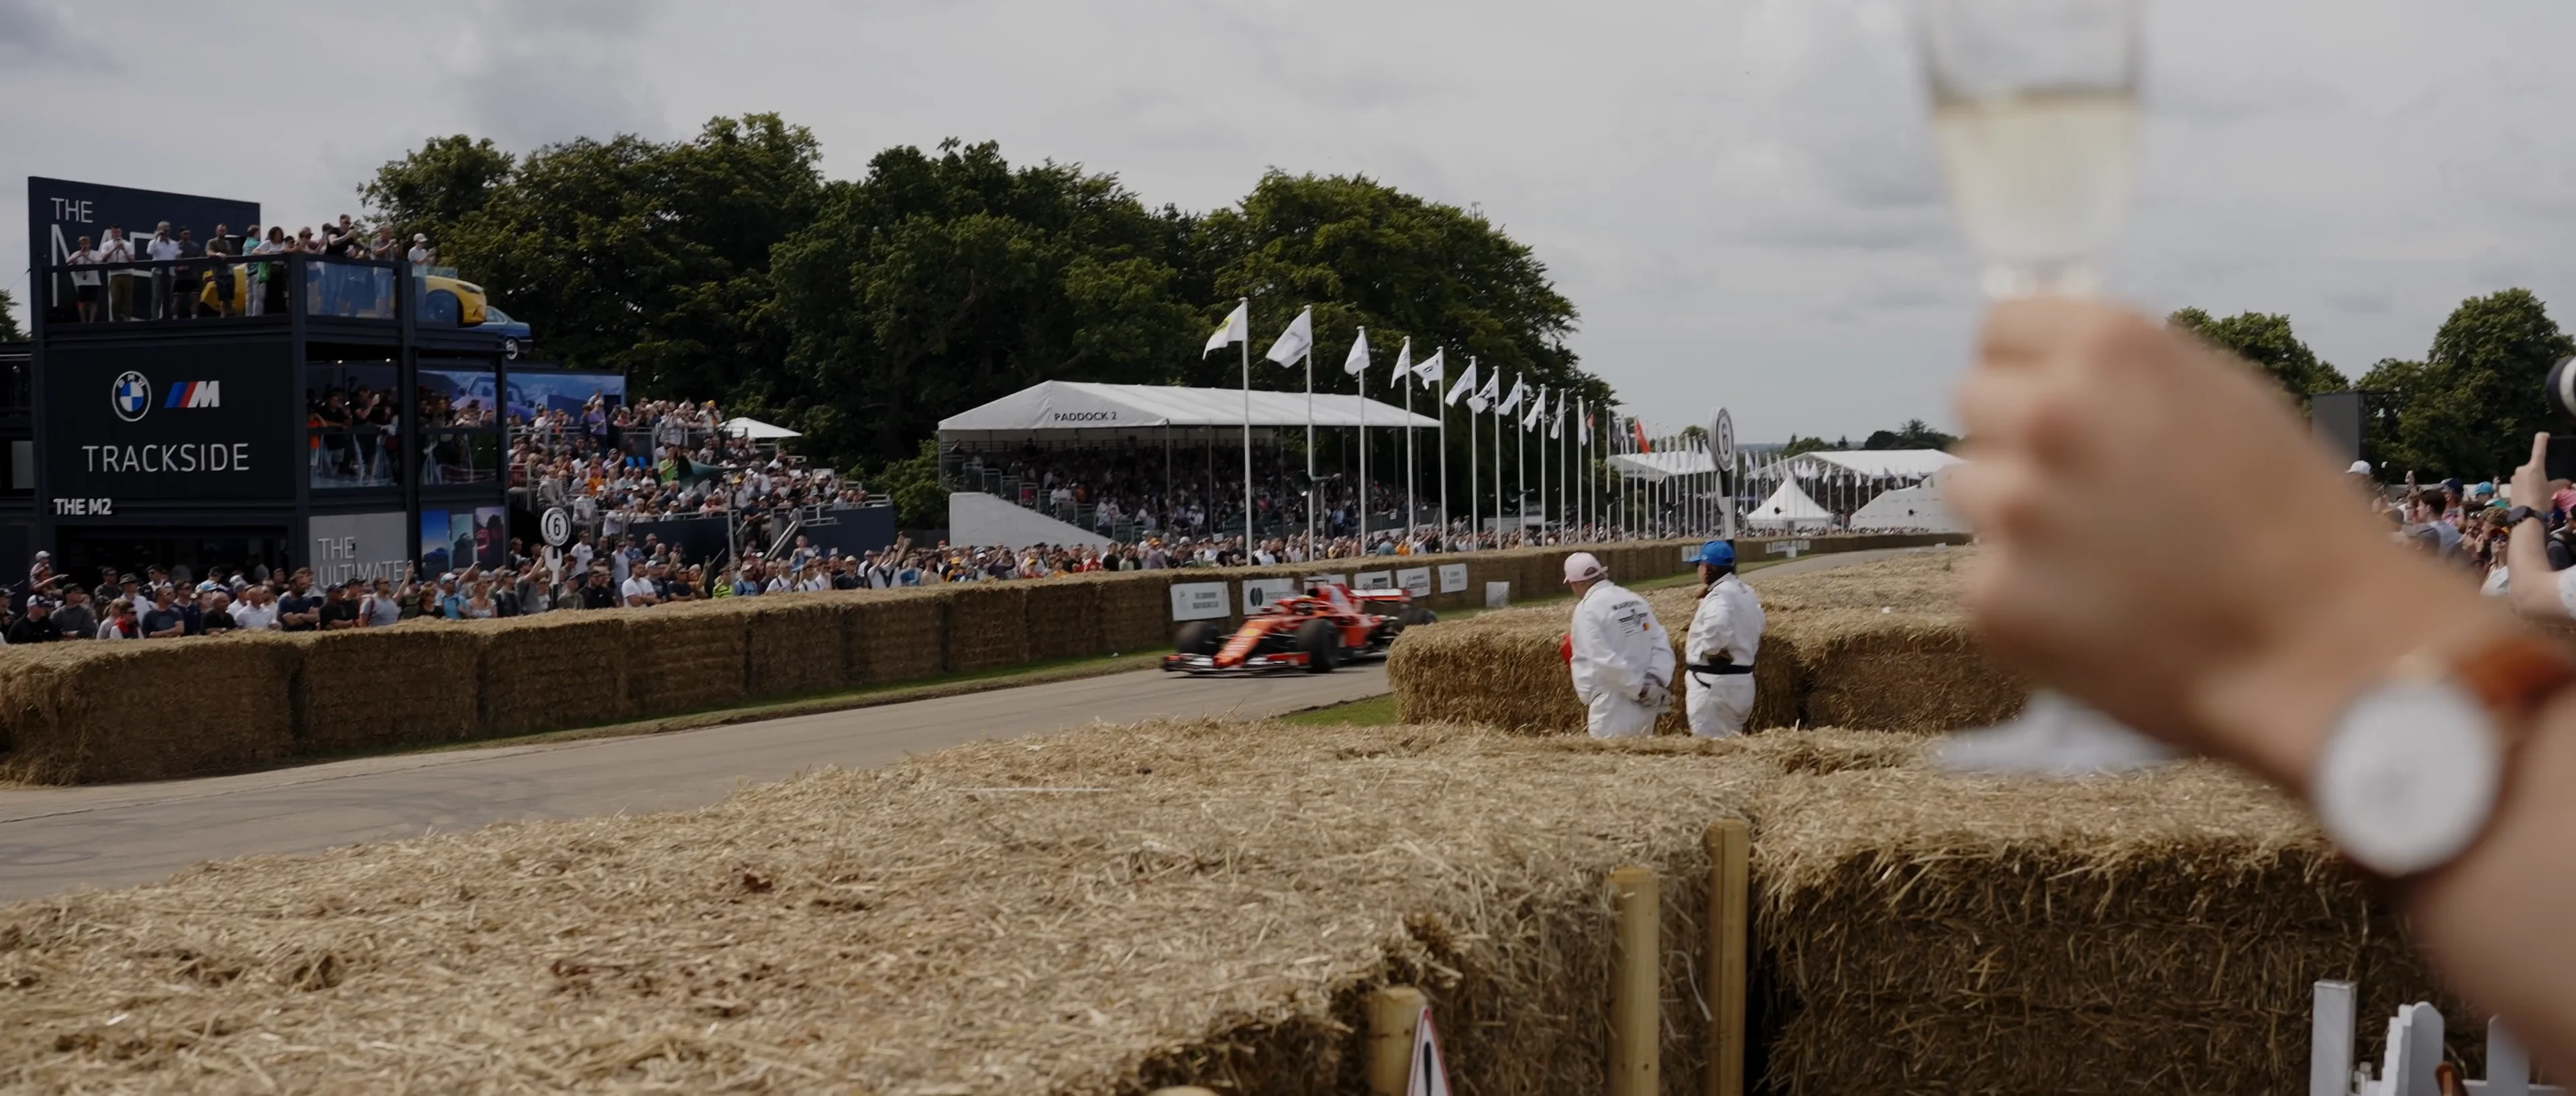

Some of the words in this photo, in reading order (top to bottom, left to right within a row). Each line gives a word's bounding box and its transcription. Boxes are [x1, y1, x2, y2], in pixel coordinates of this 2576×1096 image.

[50, 197, 93, 223] THE
[1055, 411, 1108, 421] PADDOCK
[1110, 410, 1118, 421] 2
[81, 443, 250, 472] TRACKSIDE
[53, 498, 86, 515] THE
[89, 498, 112, 515] M2
[553, 517, 561, 536] 6
[317, 537, 356, 560] THE
[319, 559, 405, 588] ULTIMATE
